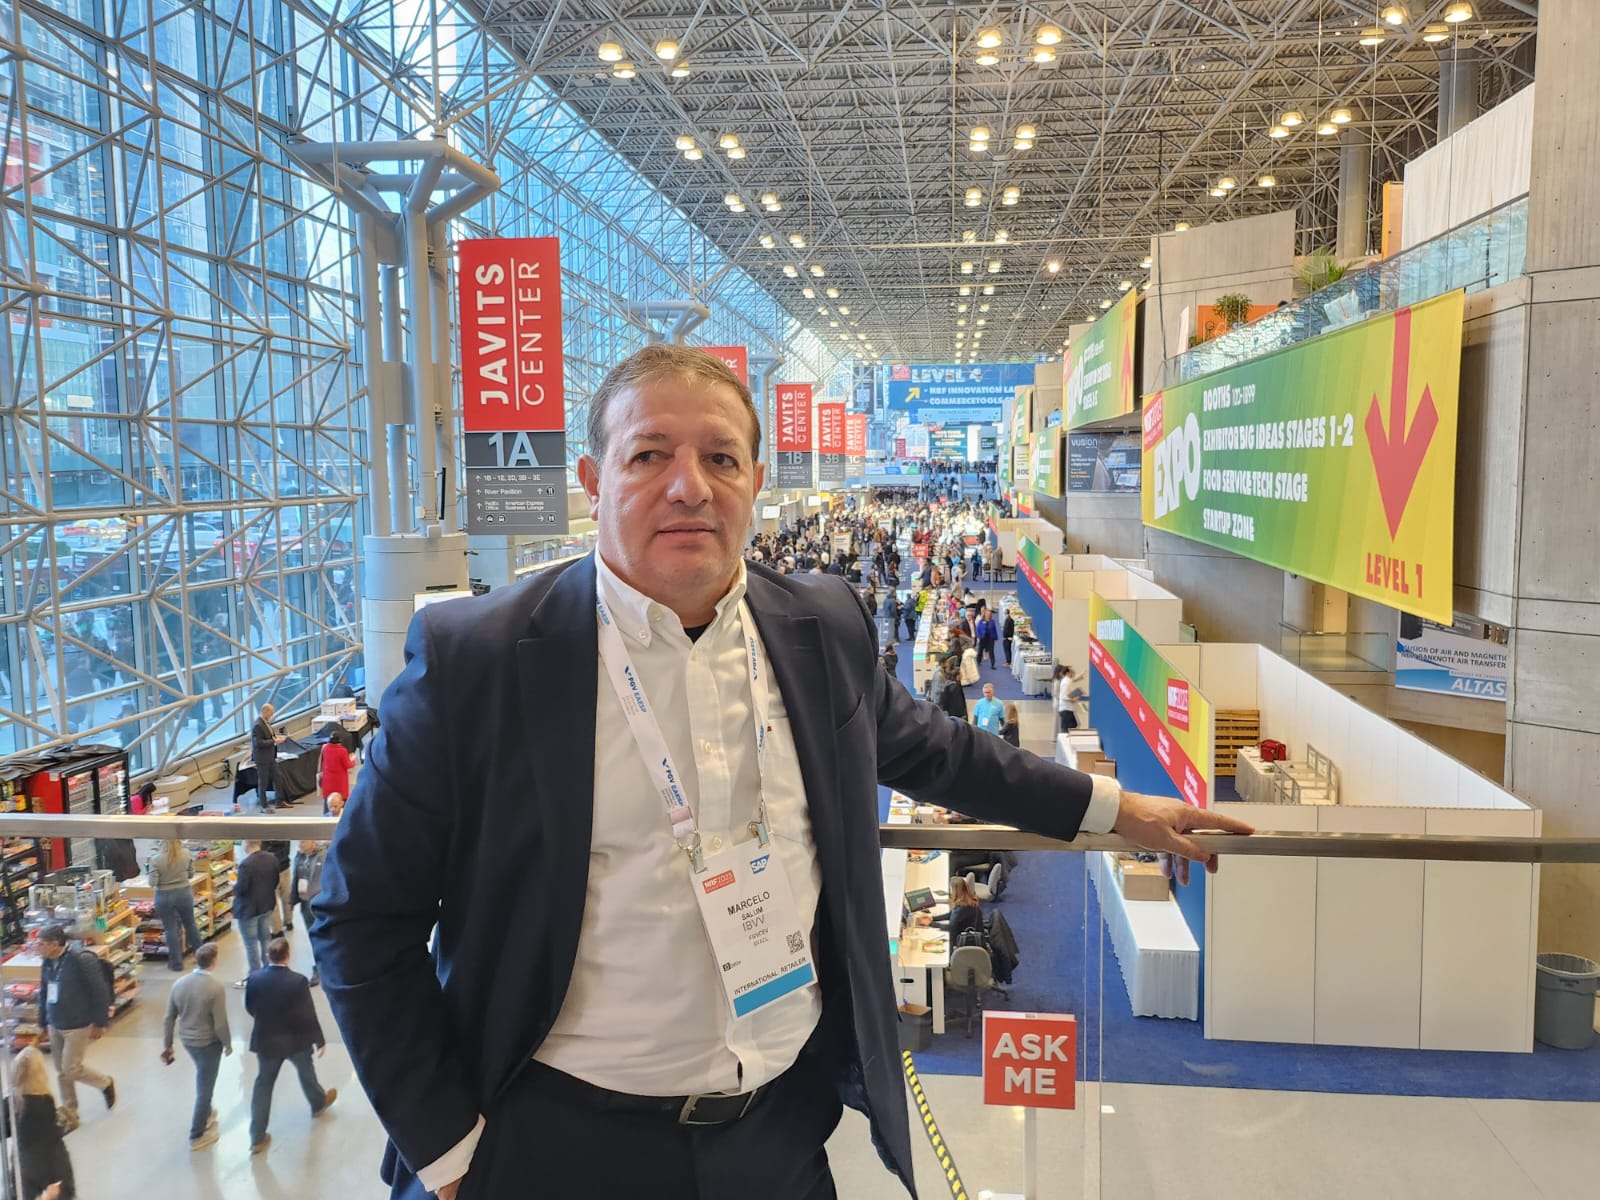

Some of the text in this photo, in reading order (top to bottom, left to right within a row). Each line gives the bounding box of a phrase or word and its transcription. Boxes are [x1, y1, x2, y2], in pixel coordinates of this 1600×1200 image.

[475, 263, 509, 405] JAVITS
[518, 261, 545, 406] CENTER
[911, 368, 965, 383] LEVEL
[947, 386, 1002, 394] INNOVATION
[1203, 384, 1231, 412] BOOTHS
[782, 391, 794, 443] JAVITS
[797, 391, 807, 443] CENTER
[822, 408, 832, 448] JAVITS
[831, 408, 842, 448] CENTER
[1203, 413, 1354, 451] EXHIBITOR BIG IDEAS STAGES 1-2
[488, 431, 540, 467] 1A
[785, 452, 804, 465] 1B
[1154, 412, 1200, 520] EXPO
[1203, 469, 1308, 502] FOOD SERVICE TECH STAGE
[1203, 508, 1255, 542] STARTUP ZONE
[1366, 552, 1423, 599] LEVEL 1
[1418, 654, 1454, 663] BANKNOTE
[1471, 659, 1506, 669] TRANSFER
[1454, 650, 1469, 658] AND
[628, 676, 638, 691] FGV
[634, 692, 647, 712] EAESP
[1450, 678, 1506, 696] ALTAS
[665, 768, 675, 784] FGV
[670, 784, 684, 807] EAESP
[751, 858, 767, 872] SAP
[727, 891, 770, 916] MARCELO
[741, 906, 763, 921] SALUM
[734, 957, 807, 996] INTERNATIONAL RETAILER
[991, 1032, 1069, 1062] ASK
[1004, 1066, 1057, 1095] ME
